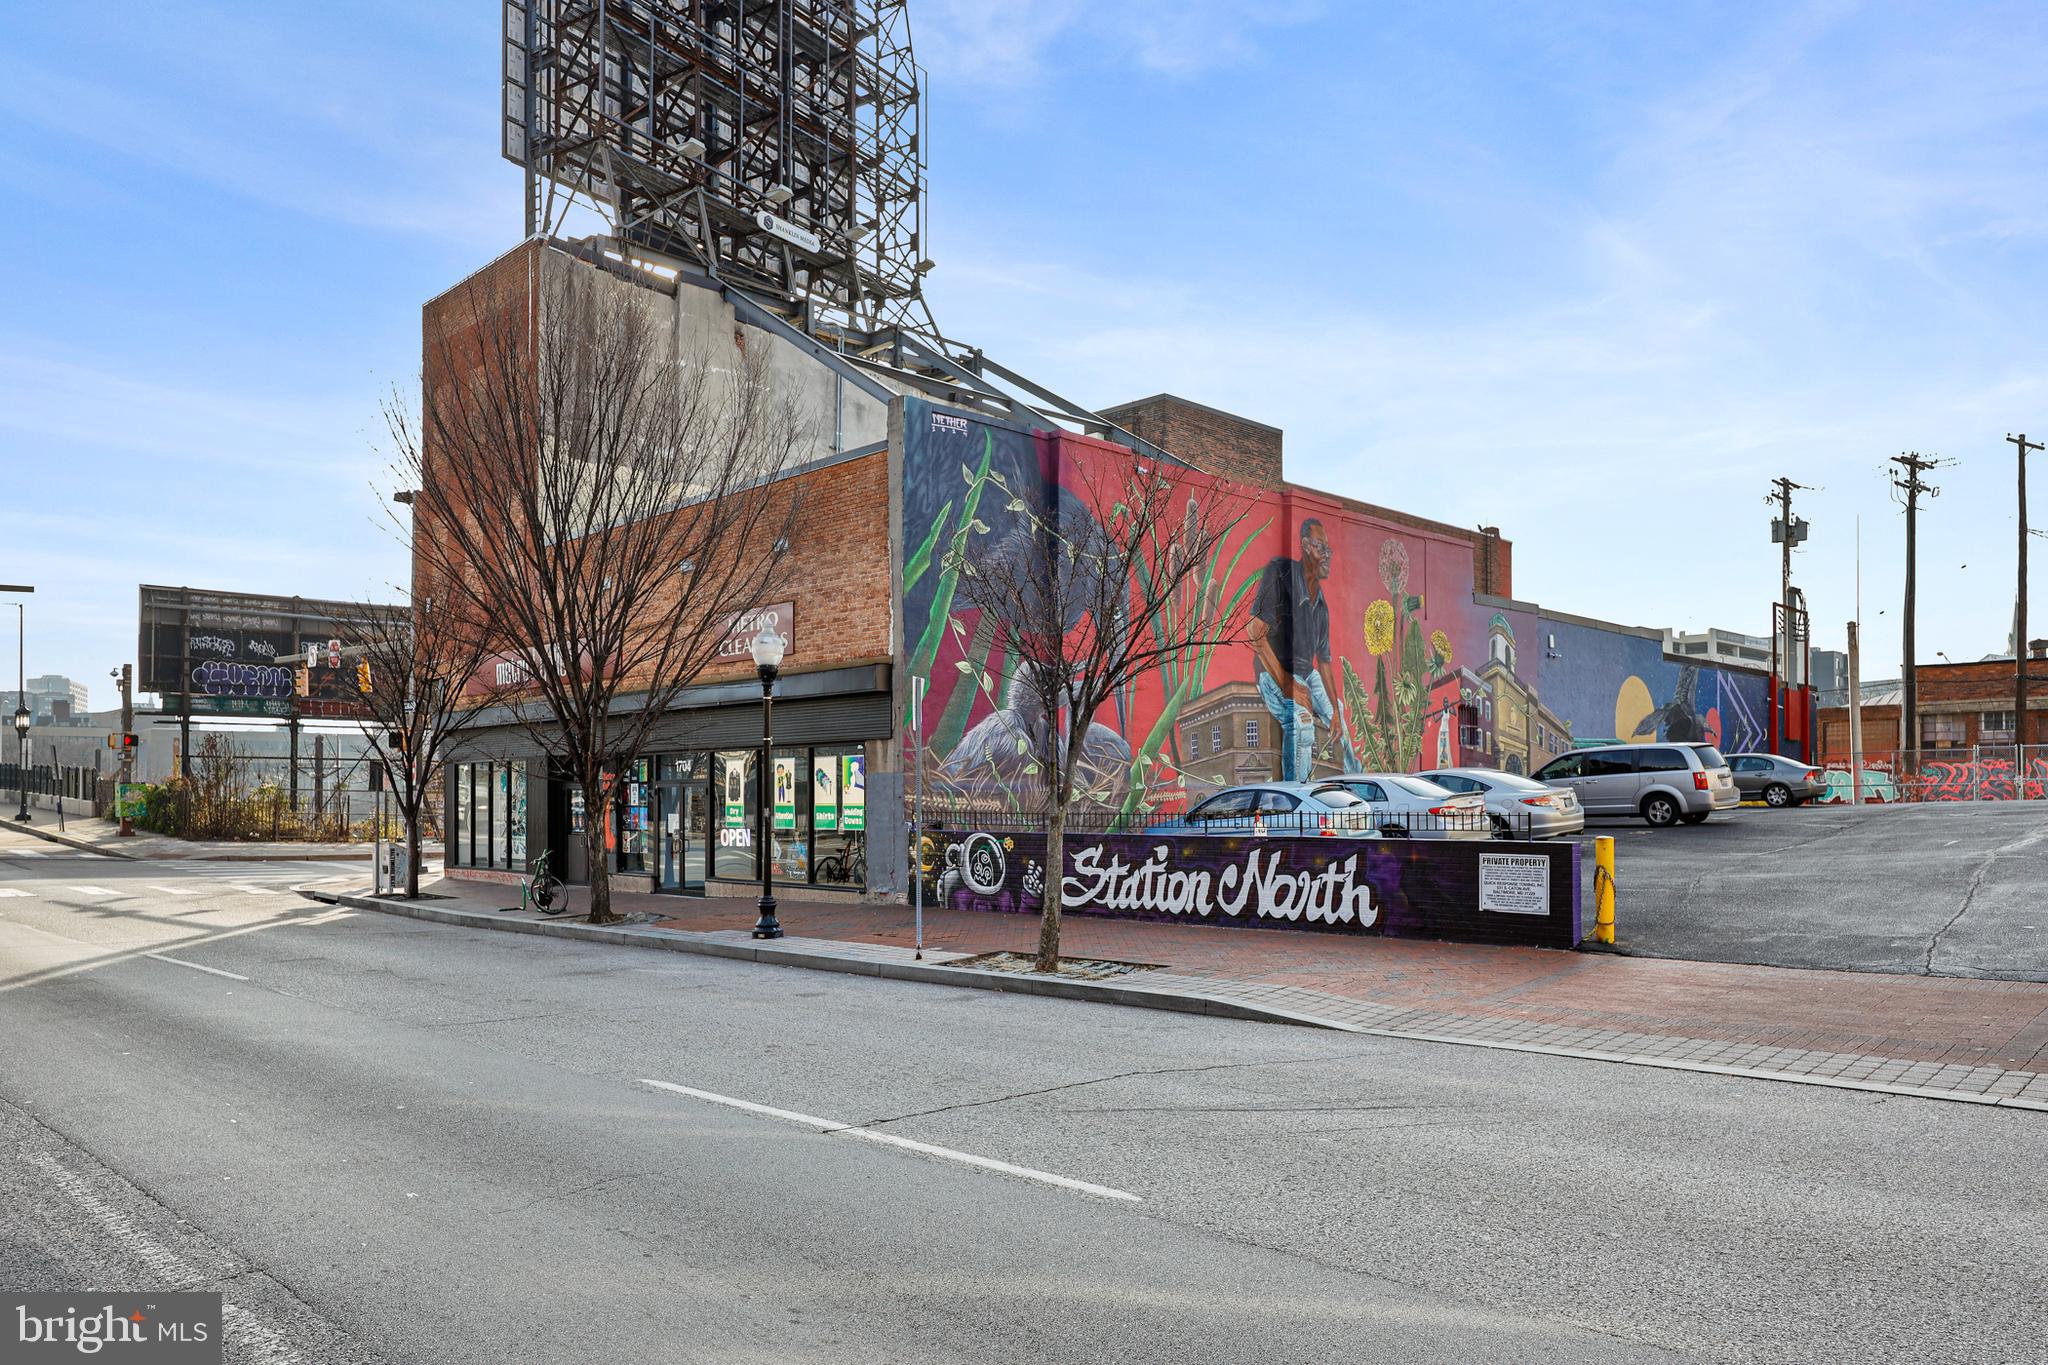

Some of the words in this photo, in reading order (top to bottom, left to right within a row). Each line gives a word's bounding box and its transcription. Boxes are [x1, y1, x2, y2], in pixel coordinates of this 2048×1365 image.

[932, 413, 967, 429] NETHER
[675, 760, 691, 772] 1704
[816, 812, 834, 820] Shirts
[720, 829, 751, 847] OPEN
[1482, 857, 1509, 865] PRIVATE
[1510, 858, 1546, 866] PROPERTY
[1061, 843, 1213, 916] Station
[1216, 848, 1378, 927] North
